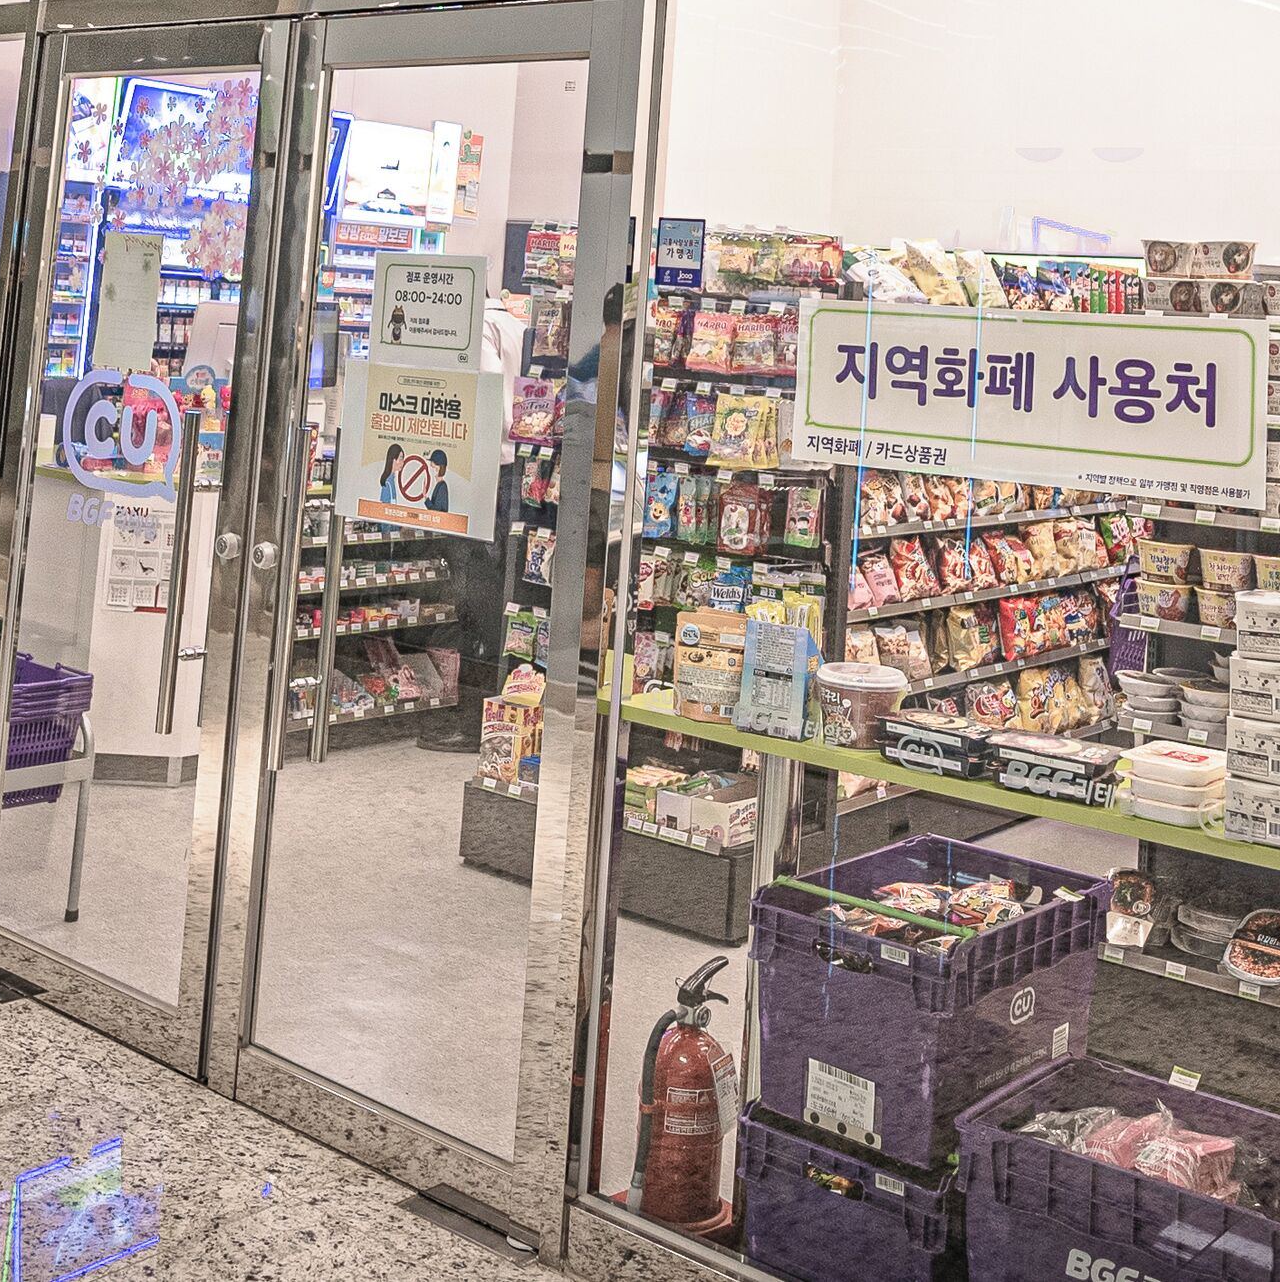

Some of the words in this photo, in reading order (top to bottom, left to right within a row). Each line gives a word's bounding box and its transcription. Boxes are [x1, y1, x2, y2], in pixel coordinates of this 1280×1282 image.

[666, 247, 694, 259] 가맹점
[406, 271, 421, 283] 점포
[423, 272, 454, 285] 운영시간
[395, 290, 462, 305] 08:00~24:00
[836, 341, 1036, 414] 지역화폐
[1053, 355, 1217, 428] 사용처
[380, 392, 418, 415] 마스크
[421, 396, 462, 420] 미착용
[84, 399, 158, 466] CU
[371, 412, 406, 433] 출입이
[407, 417, 468, 441] 제한됩니다
[806, 435, 862, 458] 지역화폐
[875, 445, 947, 467] 카드상품권
[1085, 473, 1107, 484] 지역별
[1108, 475, 1137, 487] 정책으로
[1139, 479, 1154, 488] 일부
[1155, 481, 1178, 492] 가맹점
[1179, 483, 1188, 492] 및
[1189, 484, 1220, 496] 직영점은
[1220, 488, 1251, 500] 사용불가
[1014, 994, 1031, 1016] CU
